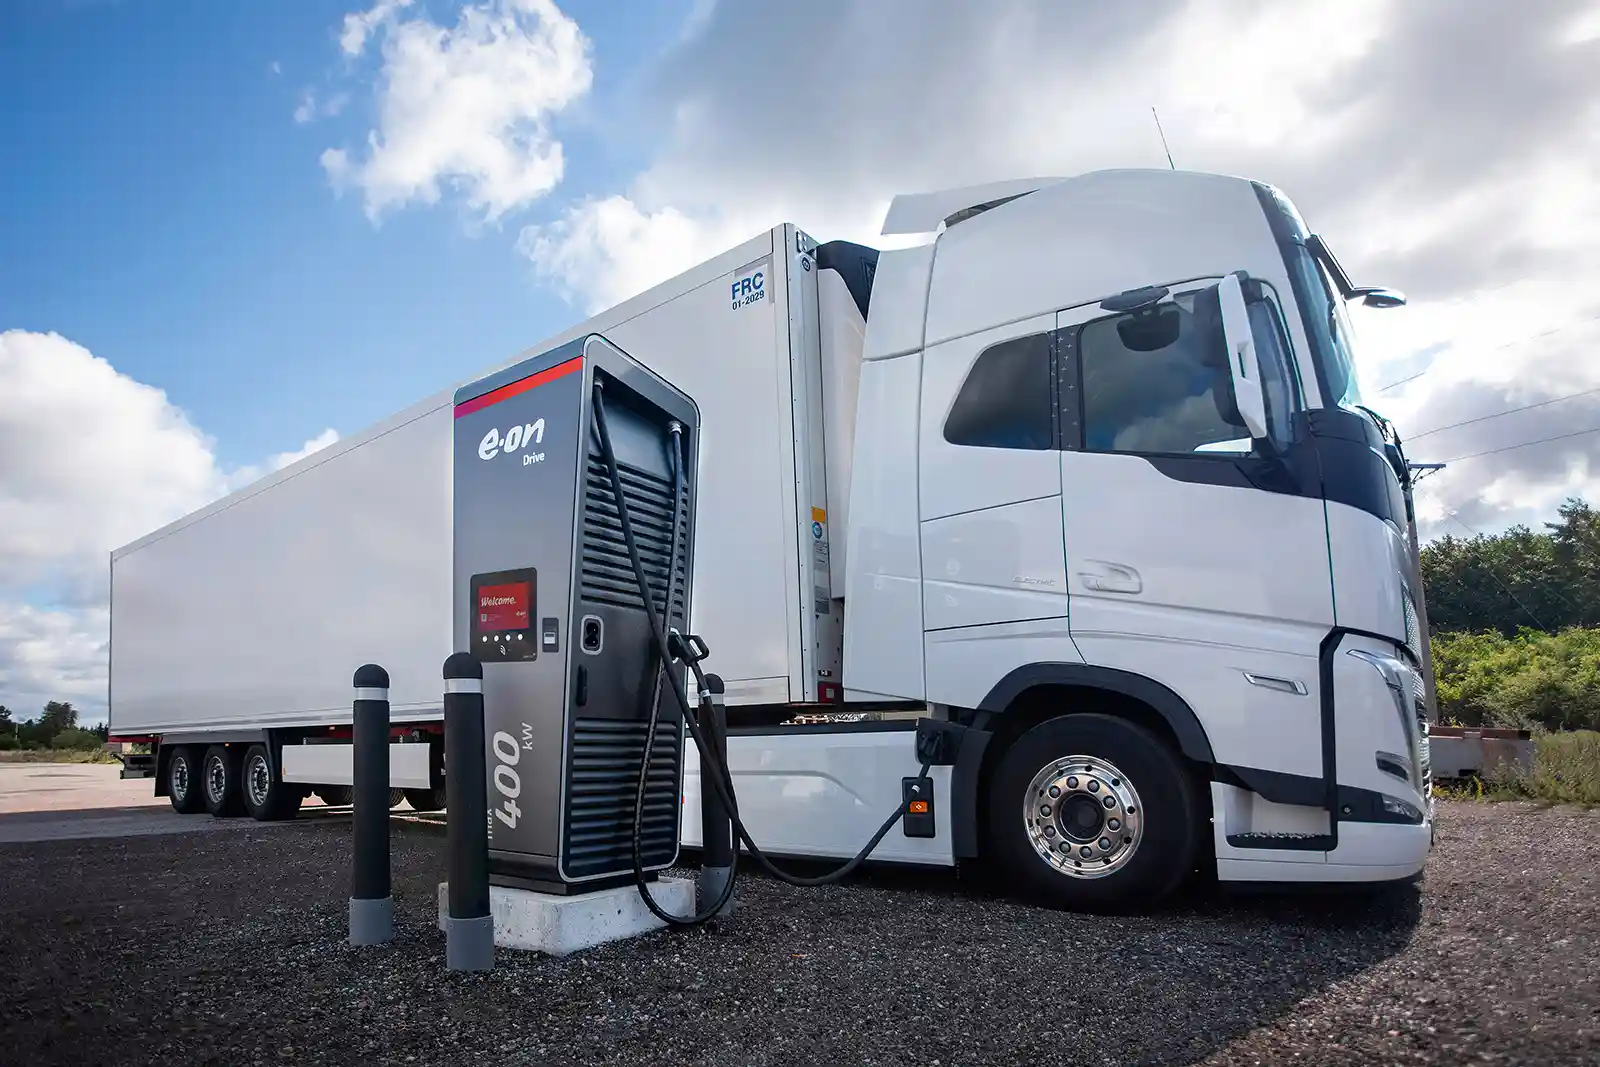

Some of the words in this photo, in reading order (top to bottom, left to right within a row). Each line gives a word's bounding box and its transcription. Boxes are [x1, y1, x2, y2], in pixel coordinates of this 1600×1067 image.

[731, 272, 764, 300] FRC
[732, 290, 765, 311] 01-2029
[523, 452, 545, 466] Drive
[481, 596, 516, 607] Welcome.
[522, 722, 533, 750] kW
[493, 731, 522, 829] 400
